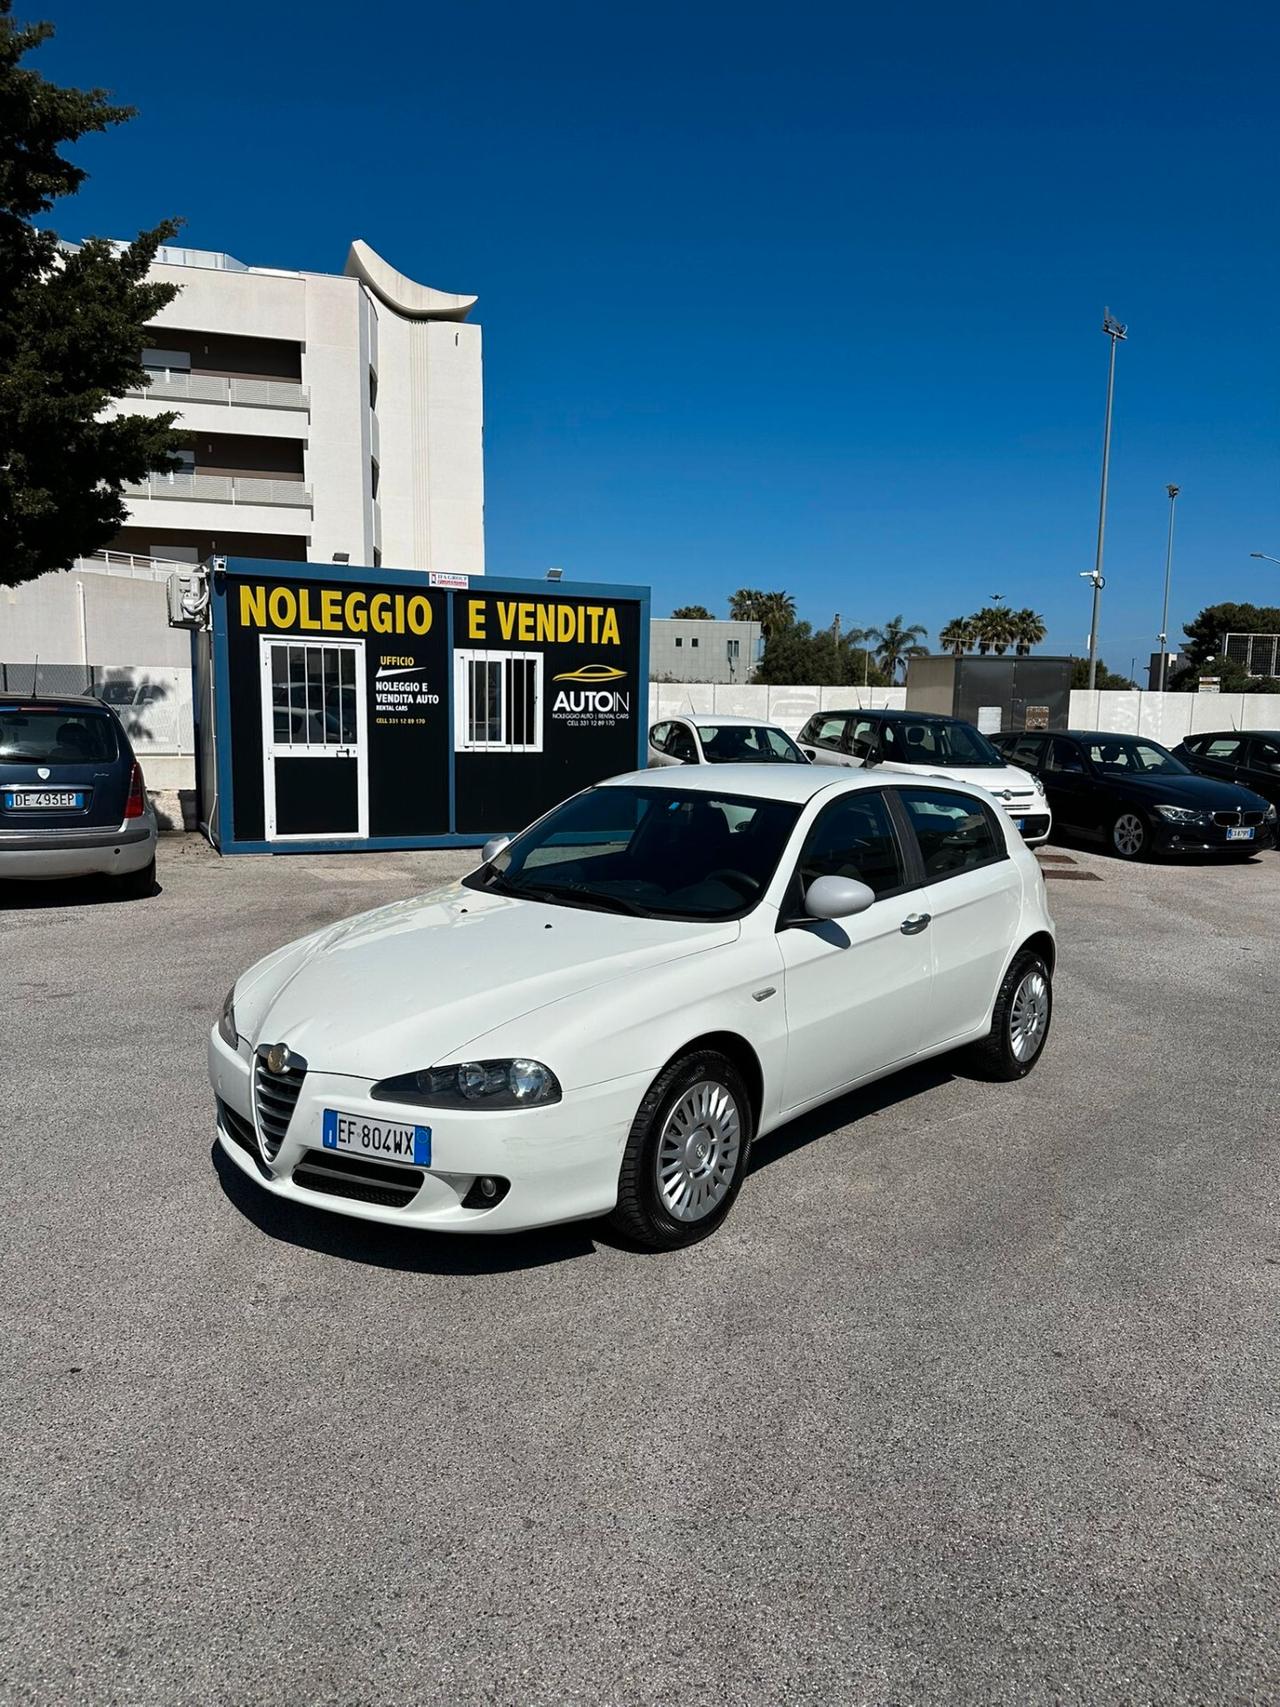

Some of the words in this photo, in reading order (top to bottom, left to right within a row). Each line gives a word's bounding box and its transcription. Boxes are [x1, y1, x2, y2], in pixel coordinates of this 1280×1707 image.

[239, 585, 433, 636] NOLEGGIO
[468, 599, 486, 639] E
[496, 601, 621, 645] VENDITA
[380, 655, 415, 666] UFFICIO
[375, 681, 420, 692] NOLEGGIO
[422, 682, 428, 692] E
[375, 693, 414, 704] VENDITA
[416, 694, 440, 704] AUTO
[552, 690, 630, 712] AUTOIN
[15, 793, 31, 806] DE
[35, 793, 75, 806] 493EP
[338, 1118, 357, 1144] EF
[361, 1124, 414, 1156] 804WX
